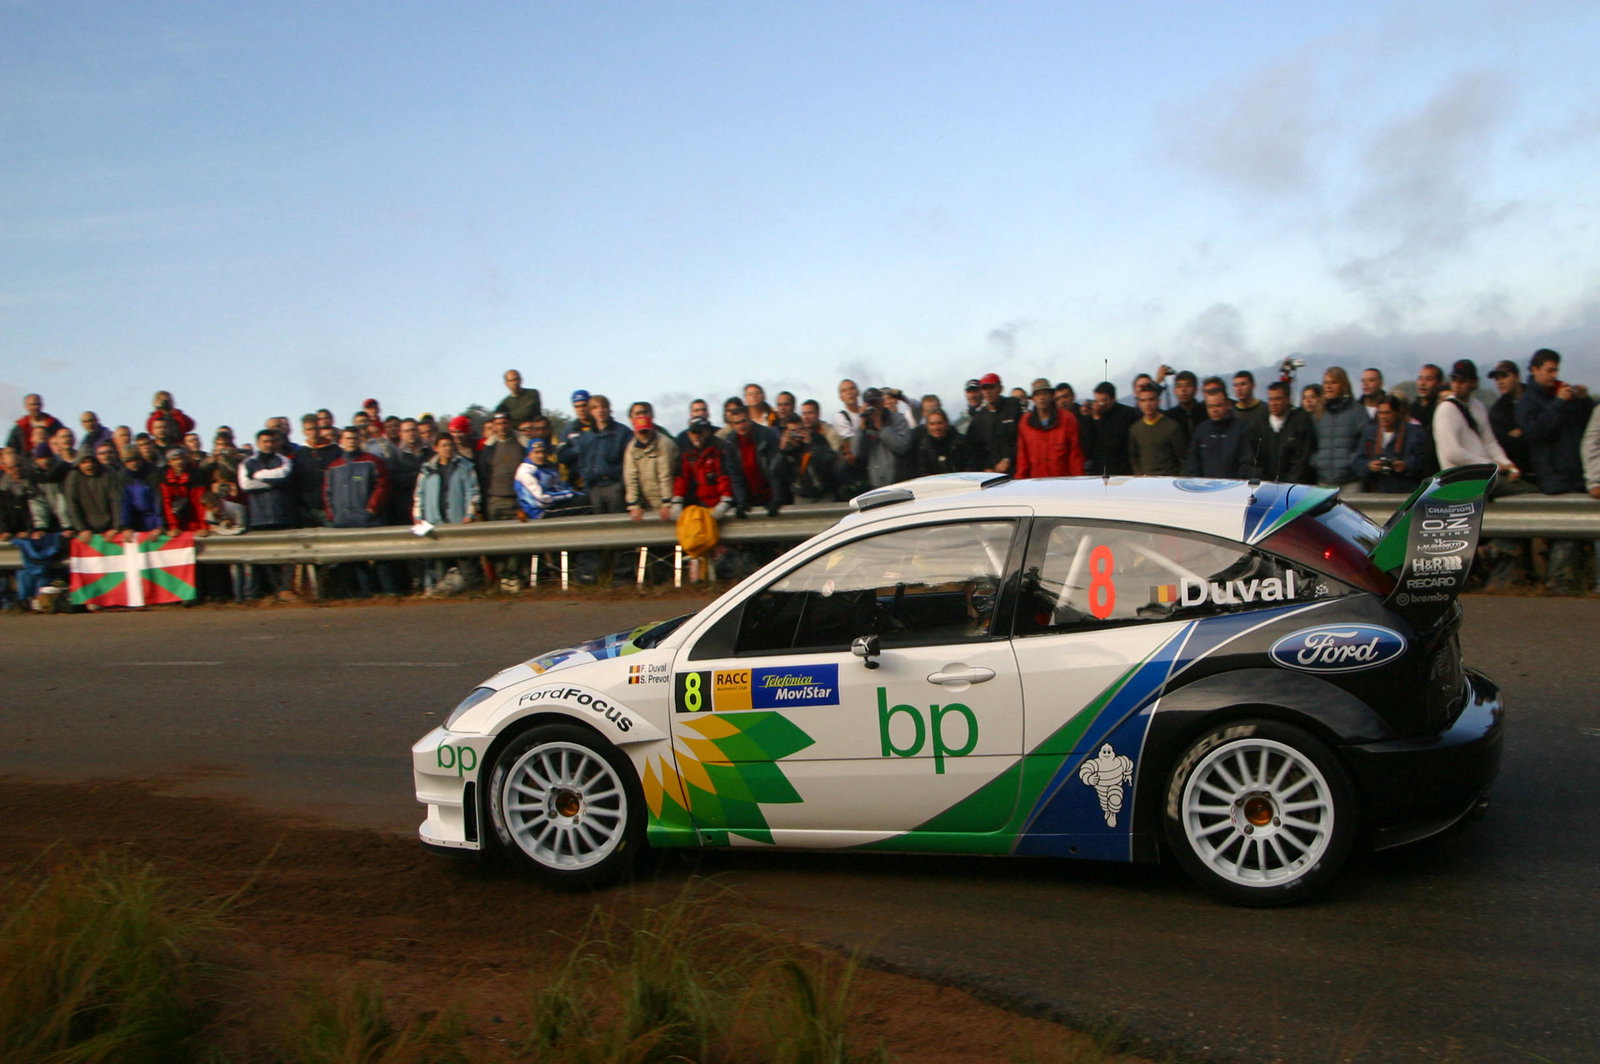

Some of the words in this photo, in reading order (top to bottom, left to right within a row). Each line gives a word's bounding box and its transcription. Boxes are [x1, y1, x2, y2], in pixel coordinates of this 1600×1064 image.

[1428, 505, 1471, 514] CHAMPION
[1412, 556, 1443, 572] H&R
[1089, 545, 1116, 620] 8
[1180, 569, 1296, 607] Duval
[1406, 576, 1456, 589] RECARO
[1411, 592, 1450, 603] brembo
[1297, 631, 1379, 665] Ford
[648, 663, 667, 673] Duval
[640, 675, 647, 684] S.
[648, 674, 670, 684] Prevot
[716, 672, 748, 685] RACC
[684, 672, 703, 712] 8
[775, 686, 832, 700] MoviStar
[876, 686, 979, 775] bp
[436, 738, 478, 778] bp
